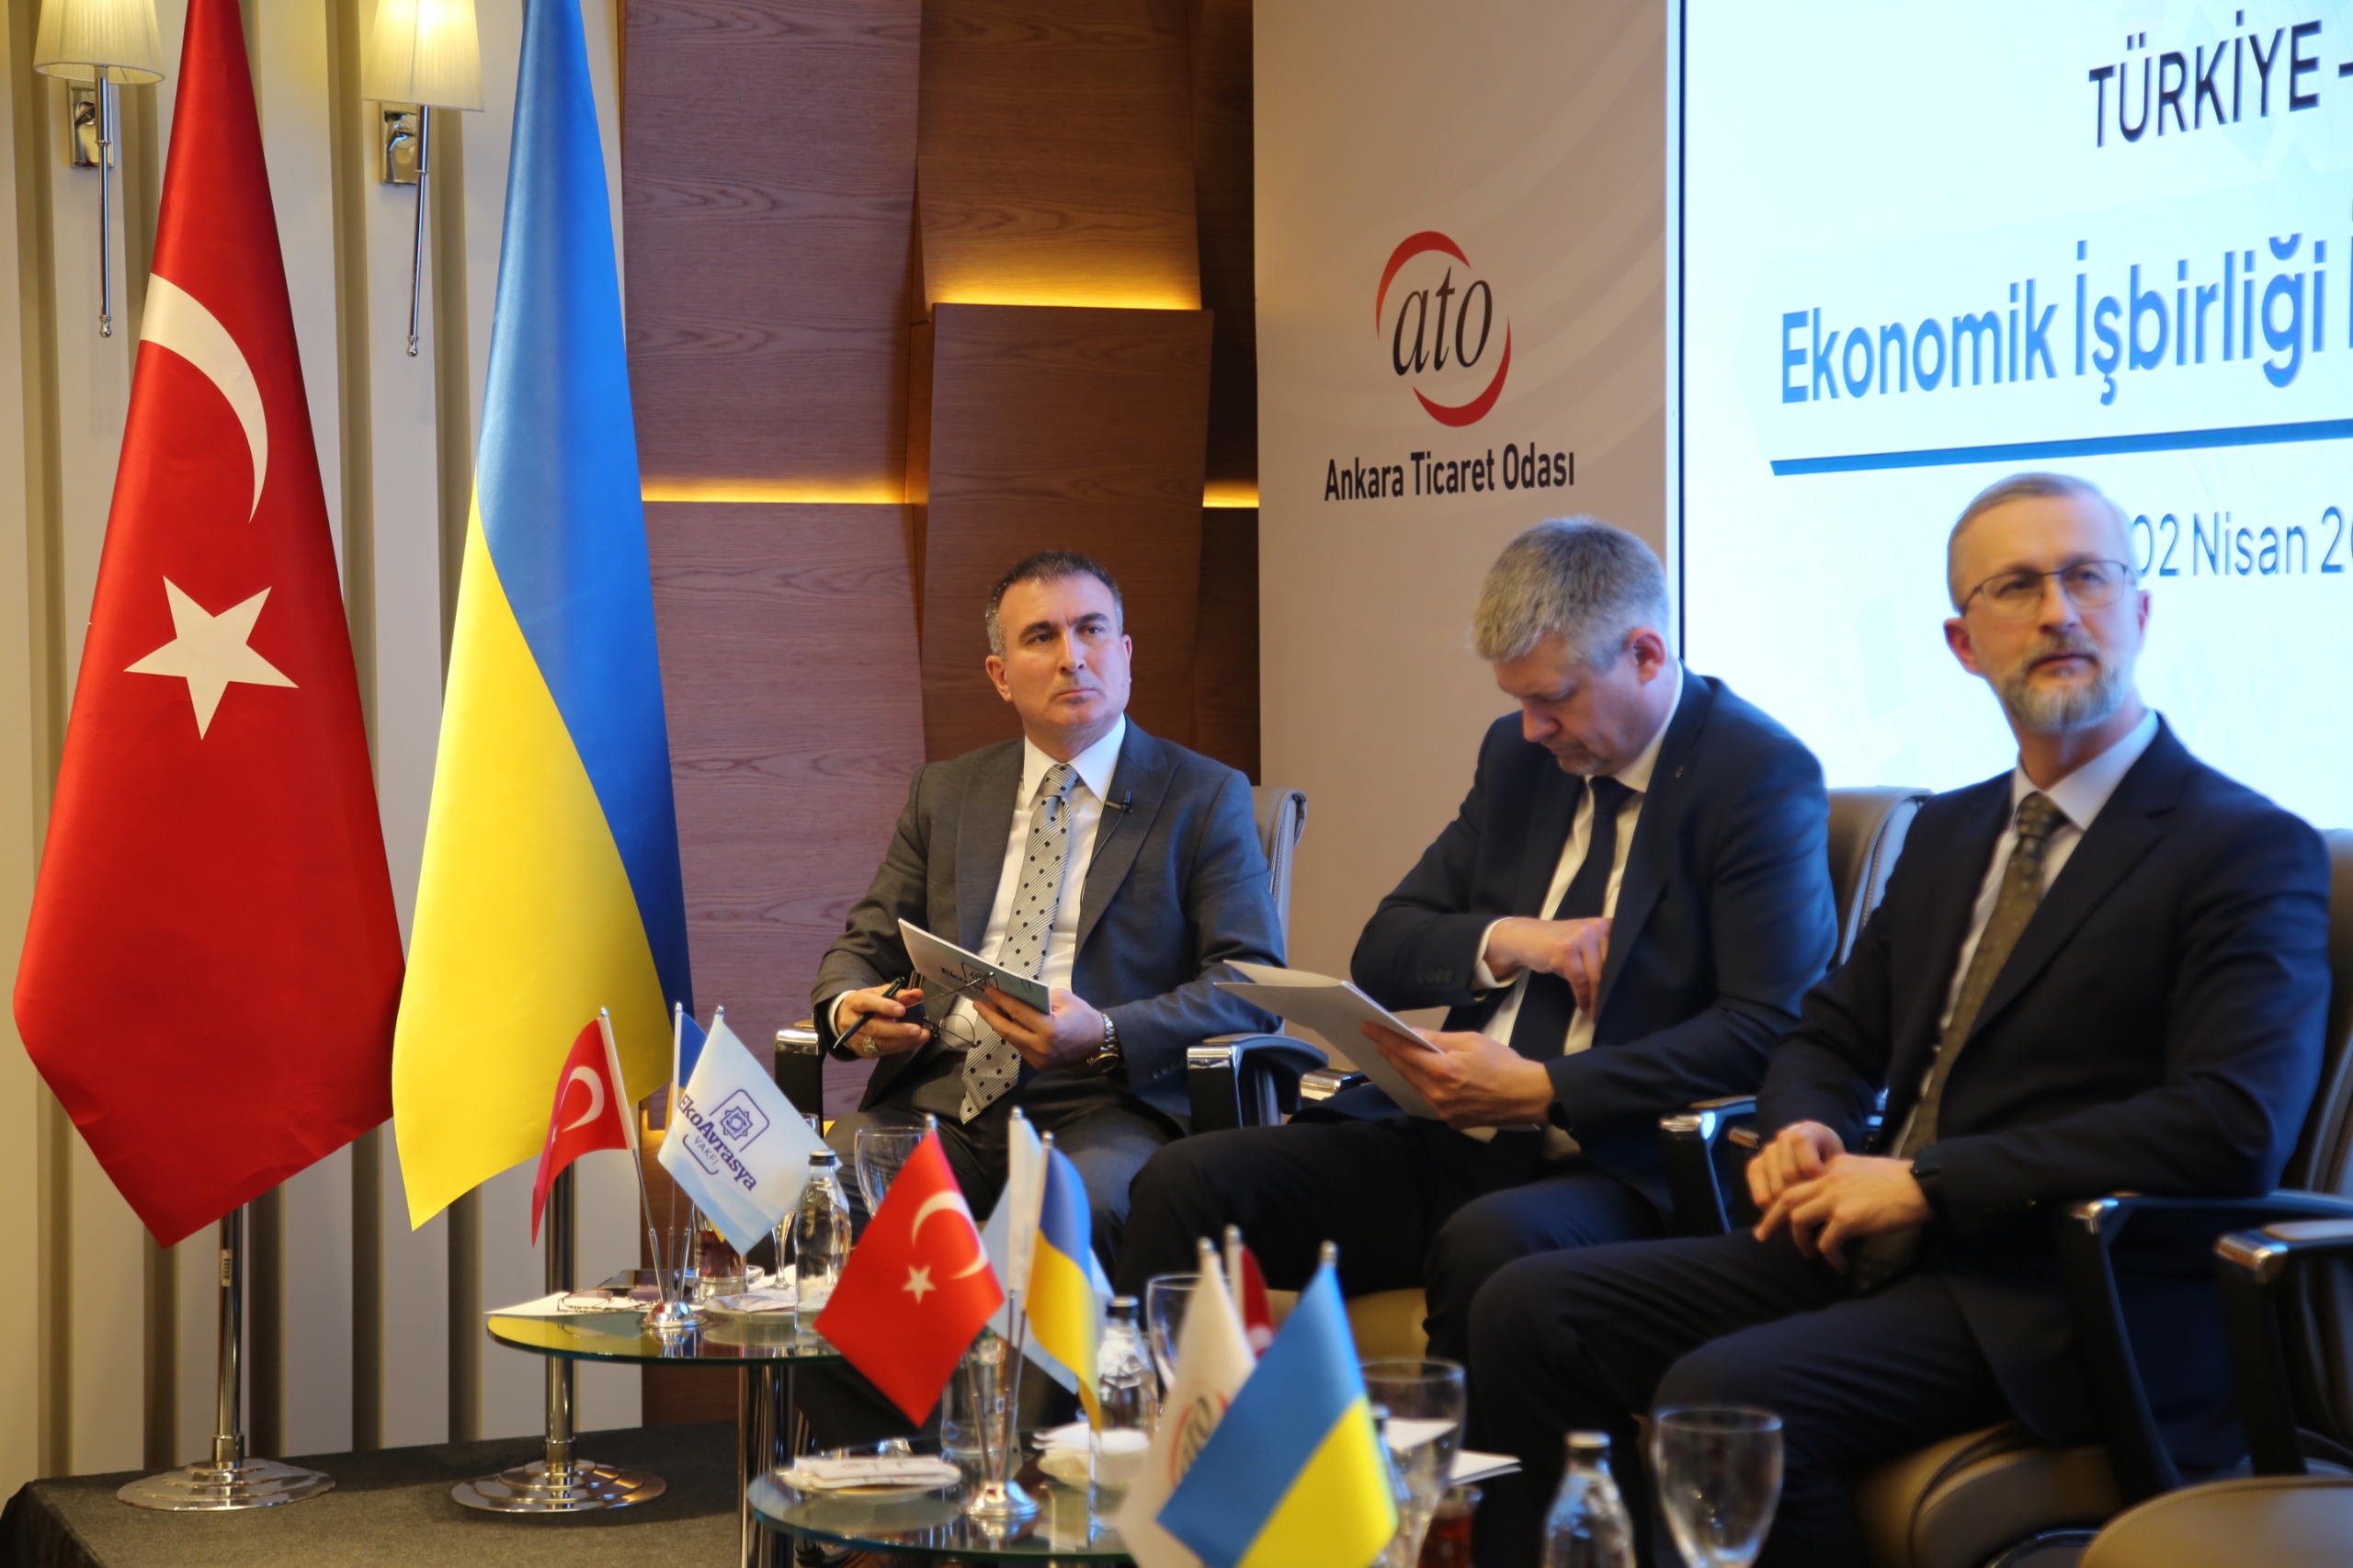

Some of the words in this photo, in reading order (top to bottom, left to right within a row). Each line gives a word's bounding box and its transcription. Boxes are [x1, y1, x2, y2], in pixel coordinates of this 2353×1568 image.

[2088, 8, 2323, 148] TÜRKİYE
[1392, 266, 1494, 377] ato
[1781, 278, 2059, 404] Ekonomik
[2075, 233, 2327, 406] İşbirliği
[1324, 457, 1404, 502] Ankara
[1410, 449, 1495, 496] Ticaret
[1502, 442, 1575, 491] Odası
[2133, 513, 2181, 577] 02
[2193, 511, 2309, 576] Nisan
[2320, 506, 2353, 574] 2
[678, 1094, 757, 1192] EkoAvrasya
[694, 1136, 719, 1165] VAKFI
